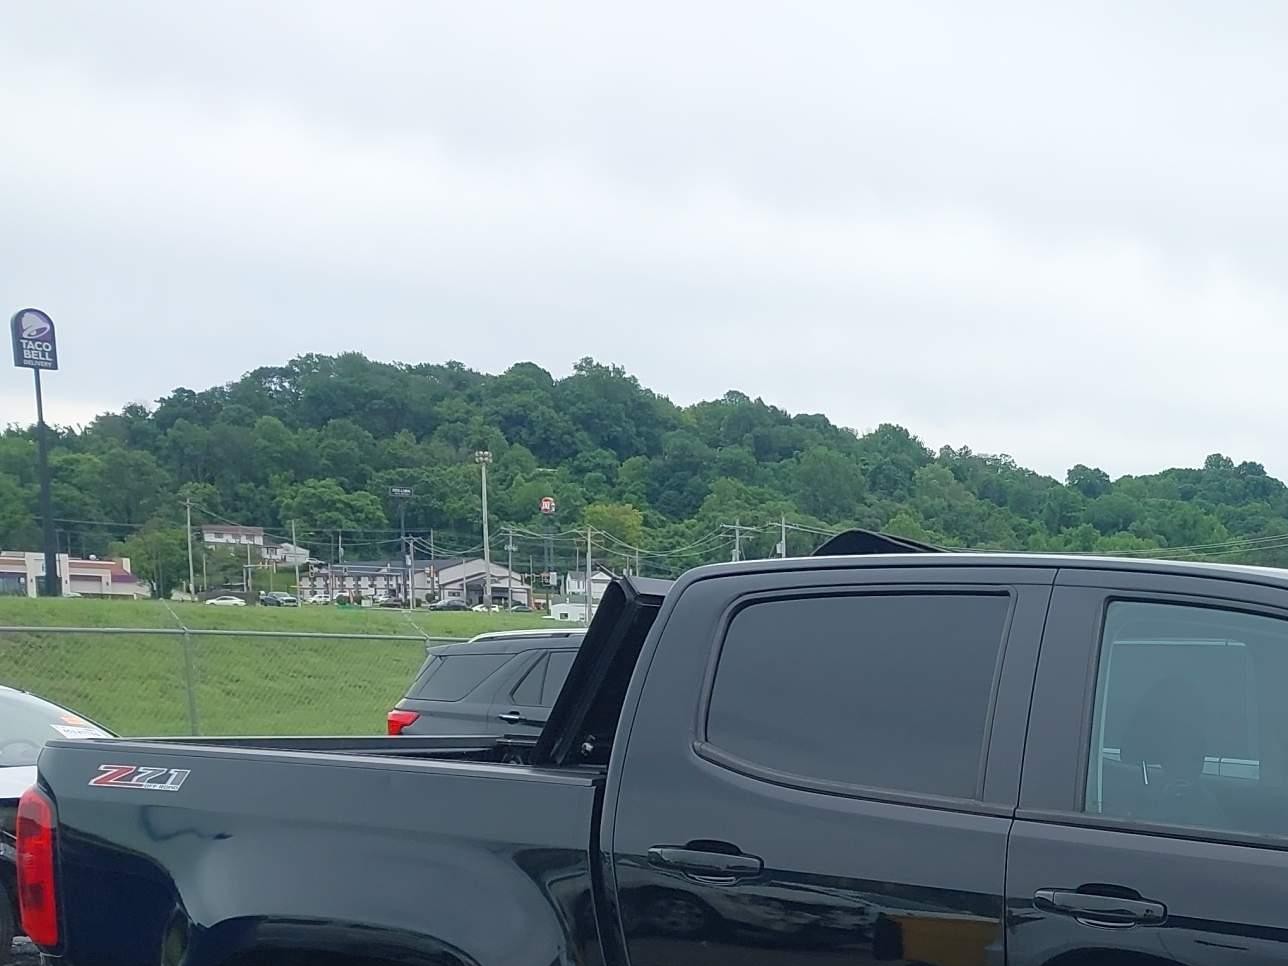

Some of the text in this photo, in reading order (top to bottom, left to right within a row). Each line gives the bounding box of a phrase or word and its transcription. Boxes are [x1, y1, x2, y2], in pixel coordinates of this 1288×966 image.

[20, 340, 52, 351] TACO
[23, 350, 54, 361] BELL
[88, 764, 192, 790] Z71
